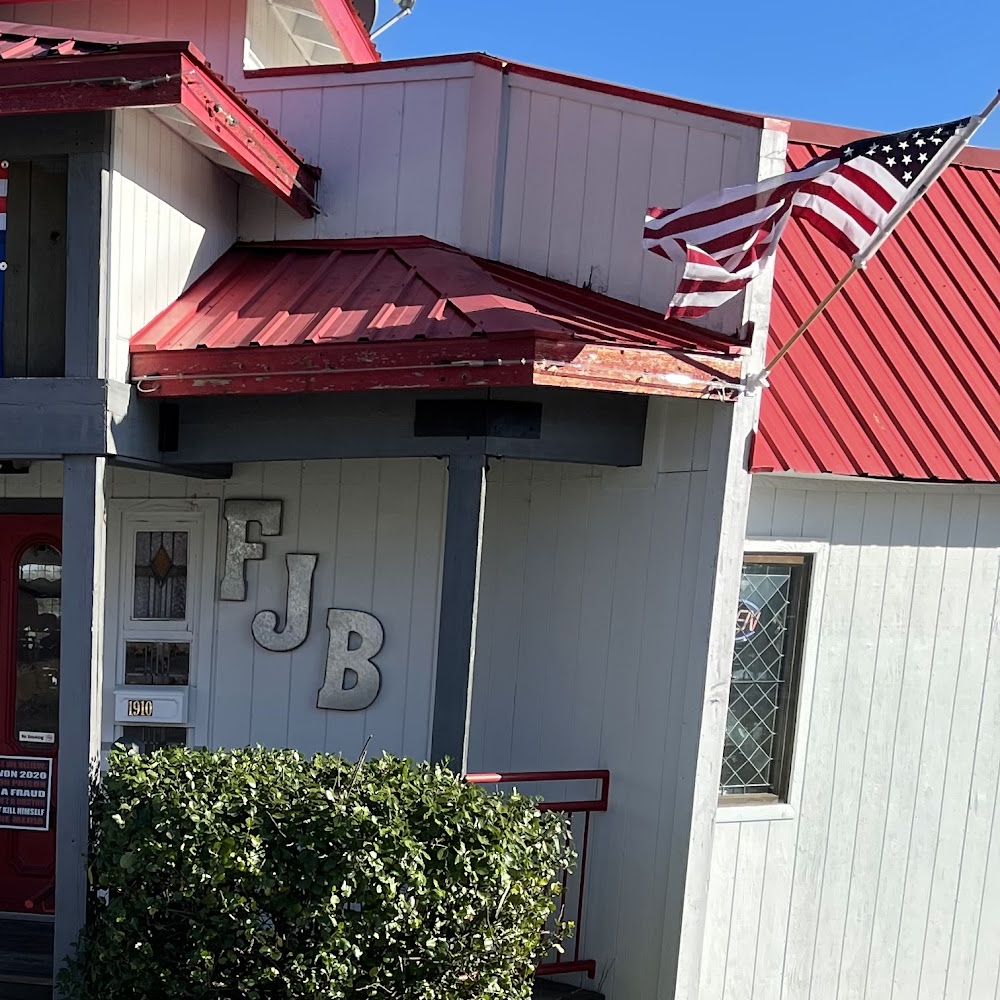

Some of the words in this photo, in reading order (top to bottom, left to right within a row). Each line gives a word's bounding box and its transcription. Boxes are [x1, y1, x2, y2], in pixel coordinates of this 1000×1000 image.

[128, 700, 153, 716] 1910
[19, 770, 48, 780] 2020
[0, 788, 9, 796] A
[10, 788, 46, 798] FRAUD
[2, 806, 17, 815] KILL
[17, 807, 45, 816] HIMSELF
